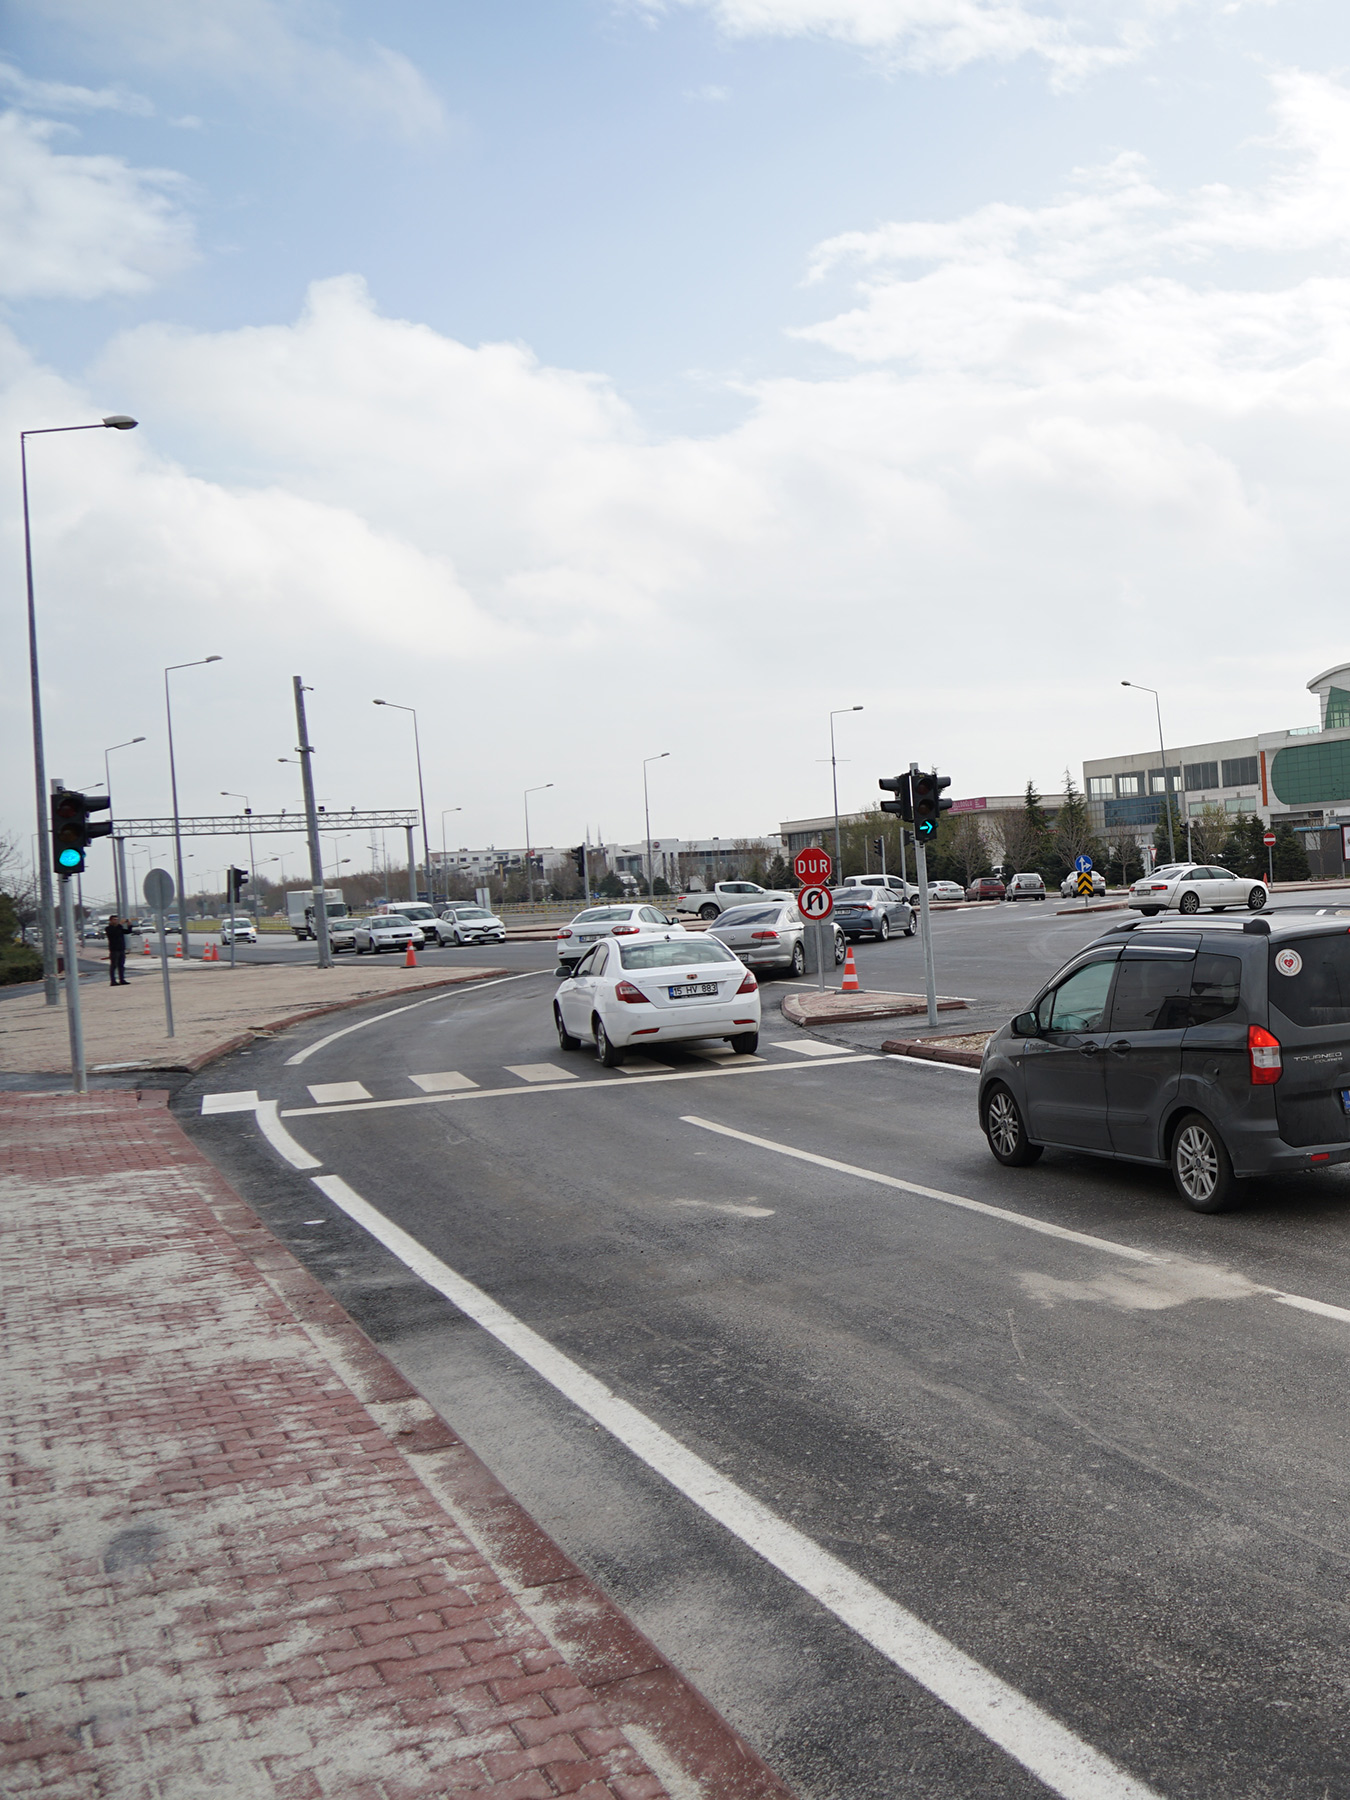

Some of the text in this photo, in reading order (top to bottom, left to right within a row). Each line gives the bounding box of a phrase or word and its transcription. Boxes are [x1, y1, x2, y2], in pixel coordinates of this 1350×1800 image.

[798, 859, 828, 873] DUR
[673, 983, 716, 995] 15 HV 883
[1293, 1051, 1342, 1061] TOURNEO
